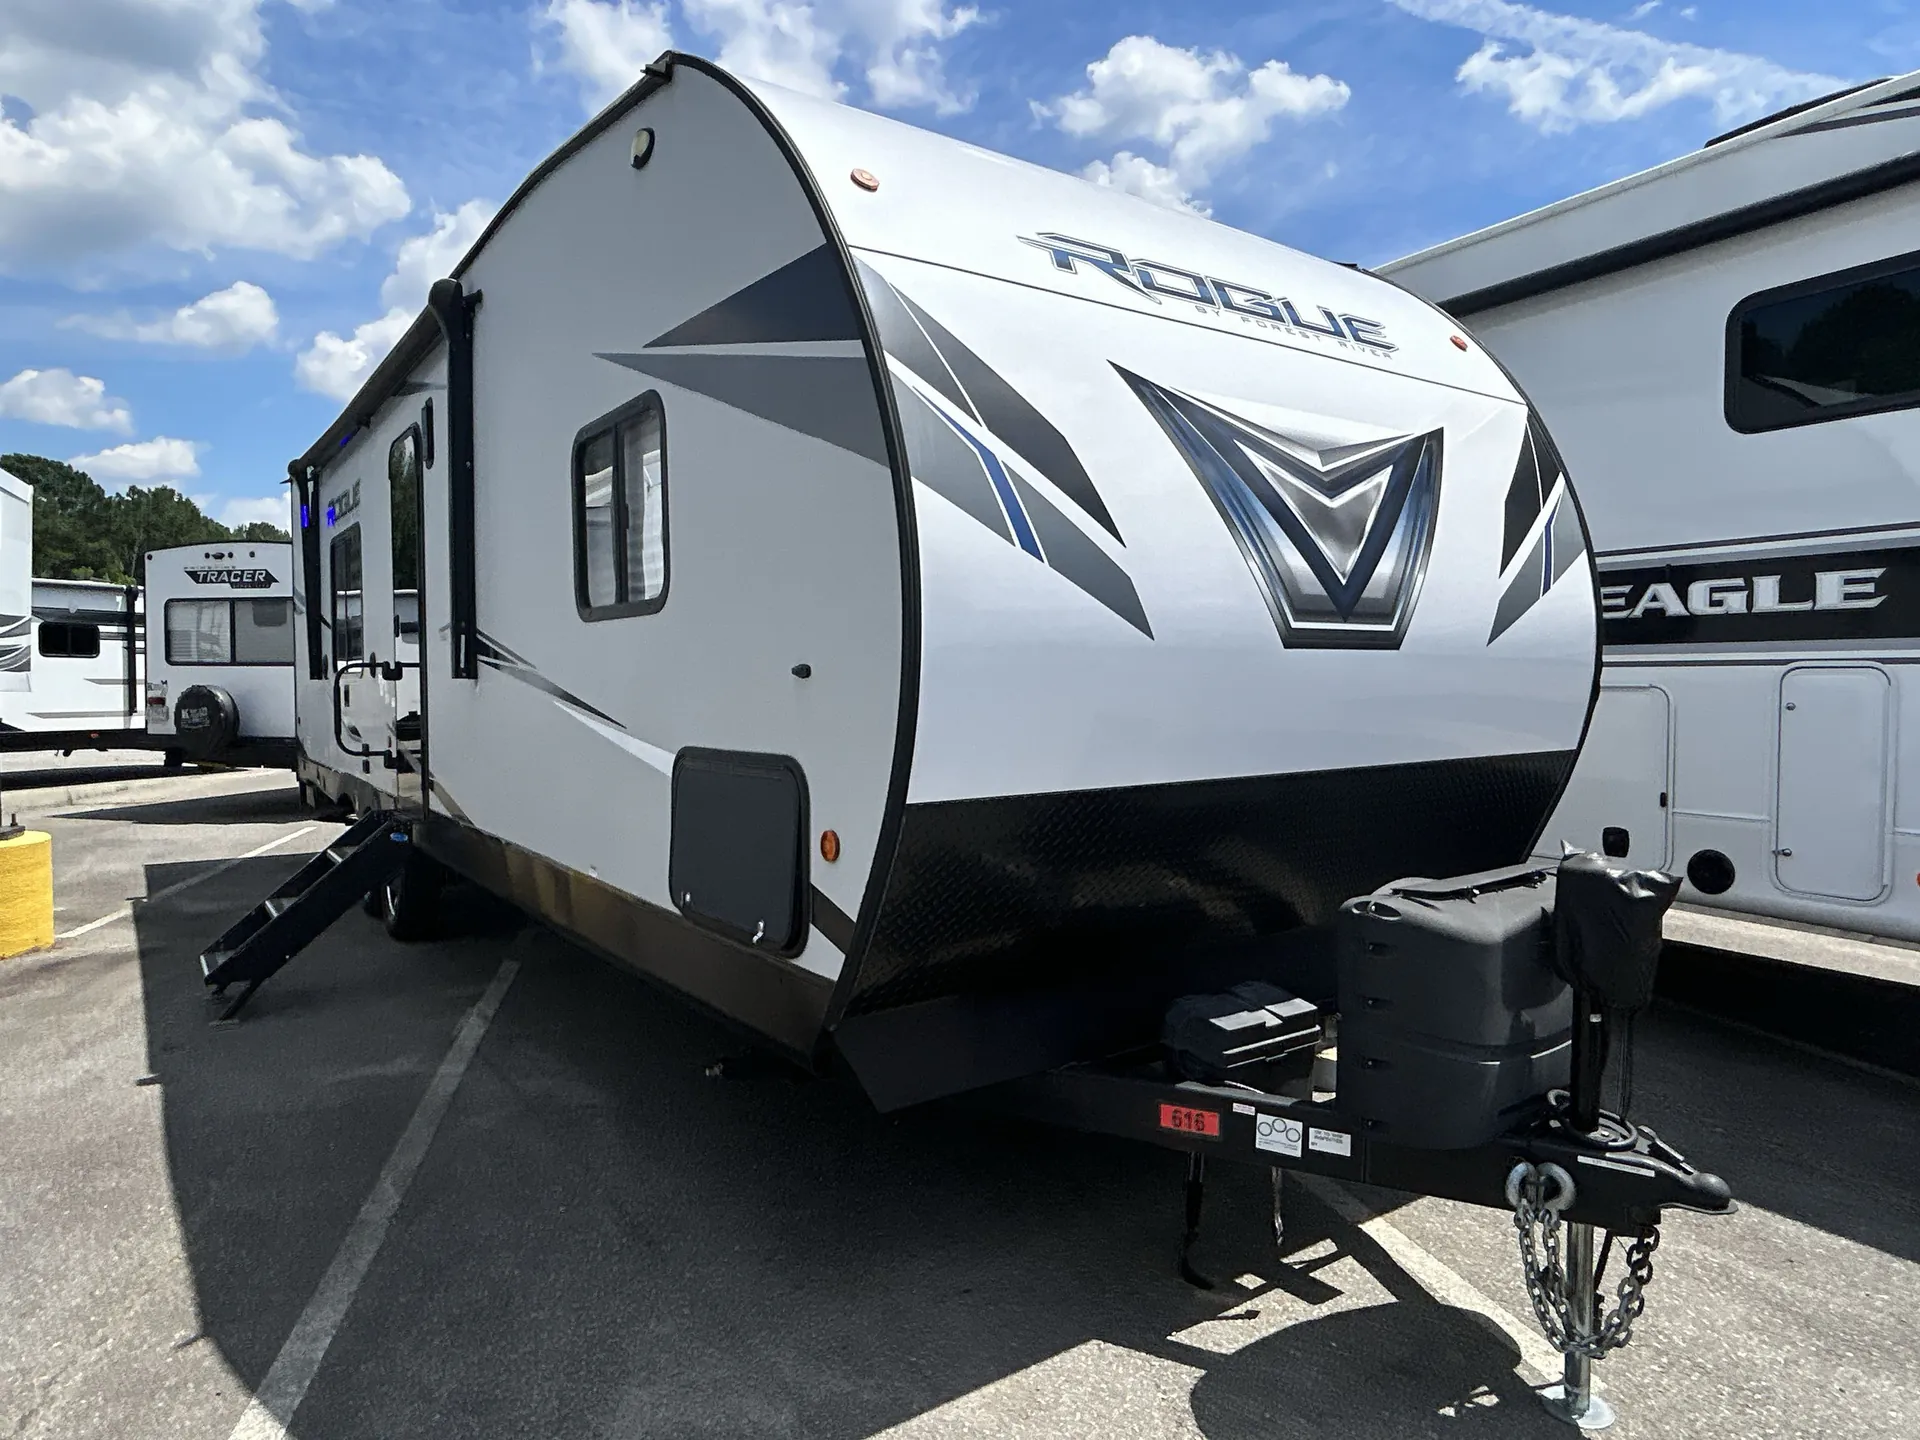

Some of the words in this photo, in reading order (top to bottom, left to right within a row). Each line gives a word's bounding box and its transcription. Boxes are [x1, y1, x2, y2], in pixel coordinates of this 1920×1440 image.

[1016, 231, 1399, 353] ROGUE
[1195, 305, 1220, 317] BY
[1241, 316, 1321, 342] FOREST
[1337, 340, 1393, 360] RIVER
[196, 569, 267, 583] TRACER
[1600, 567, 1888, 620] EAGLE
[1171, 1108, 1205, 1132] 616
